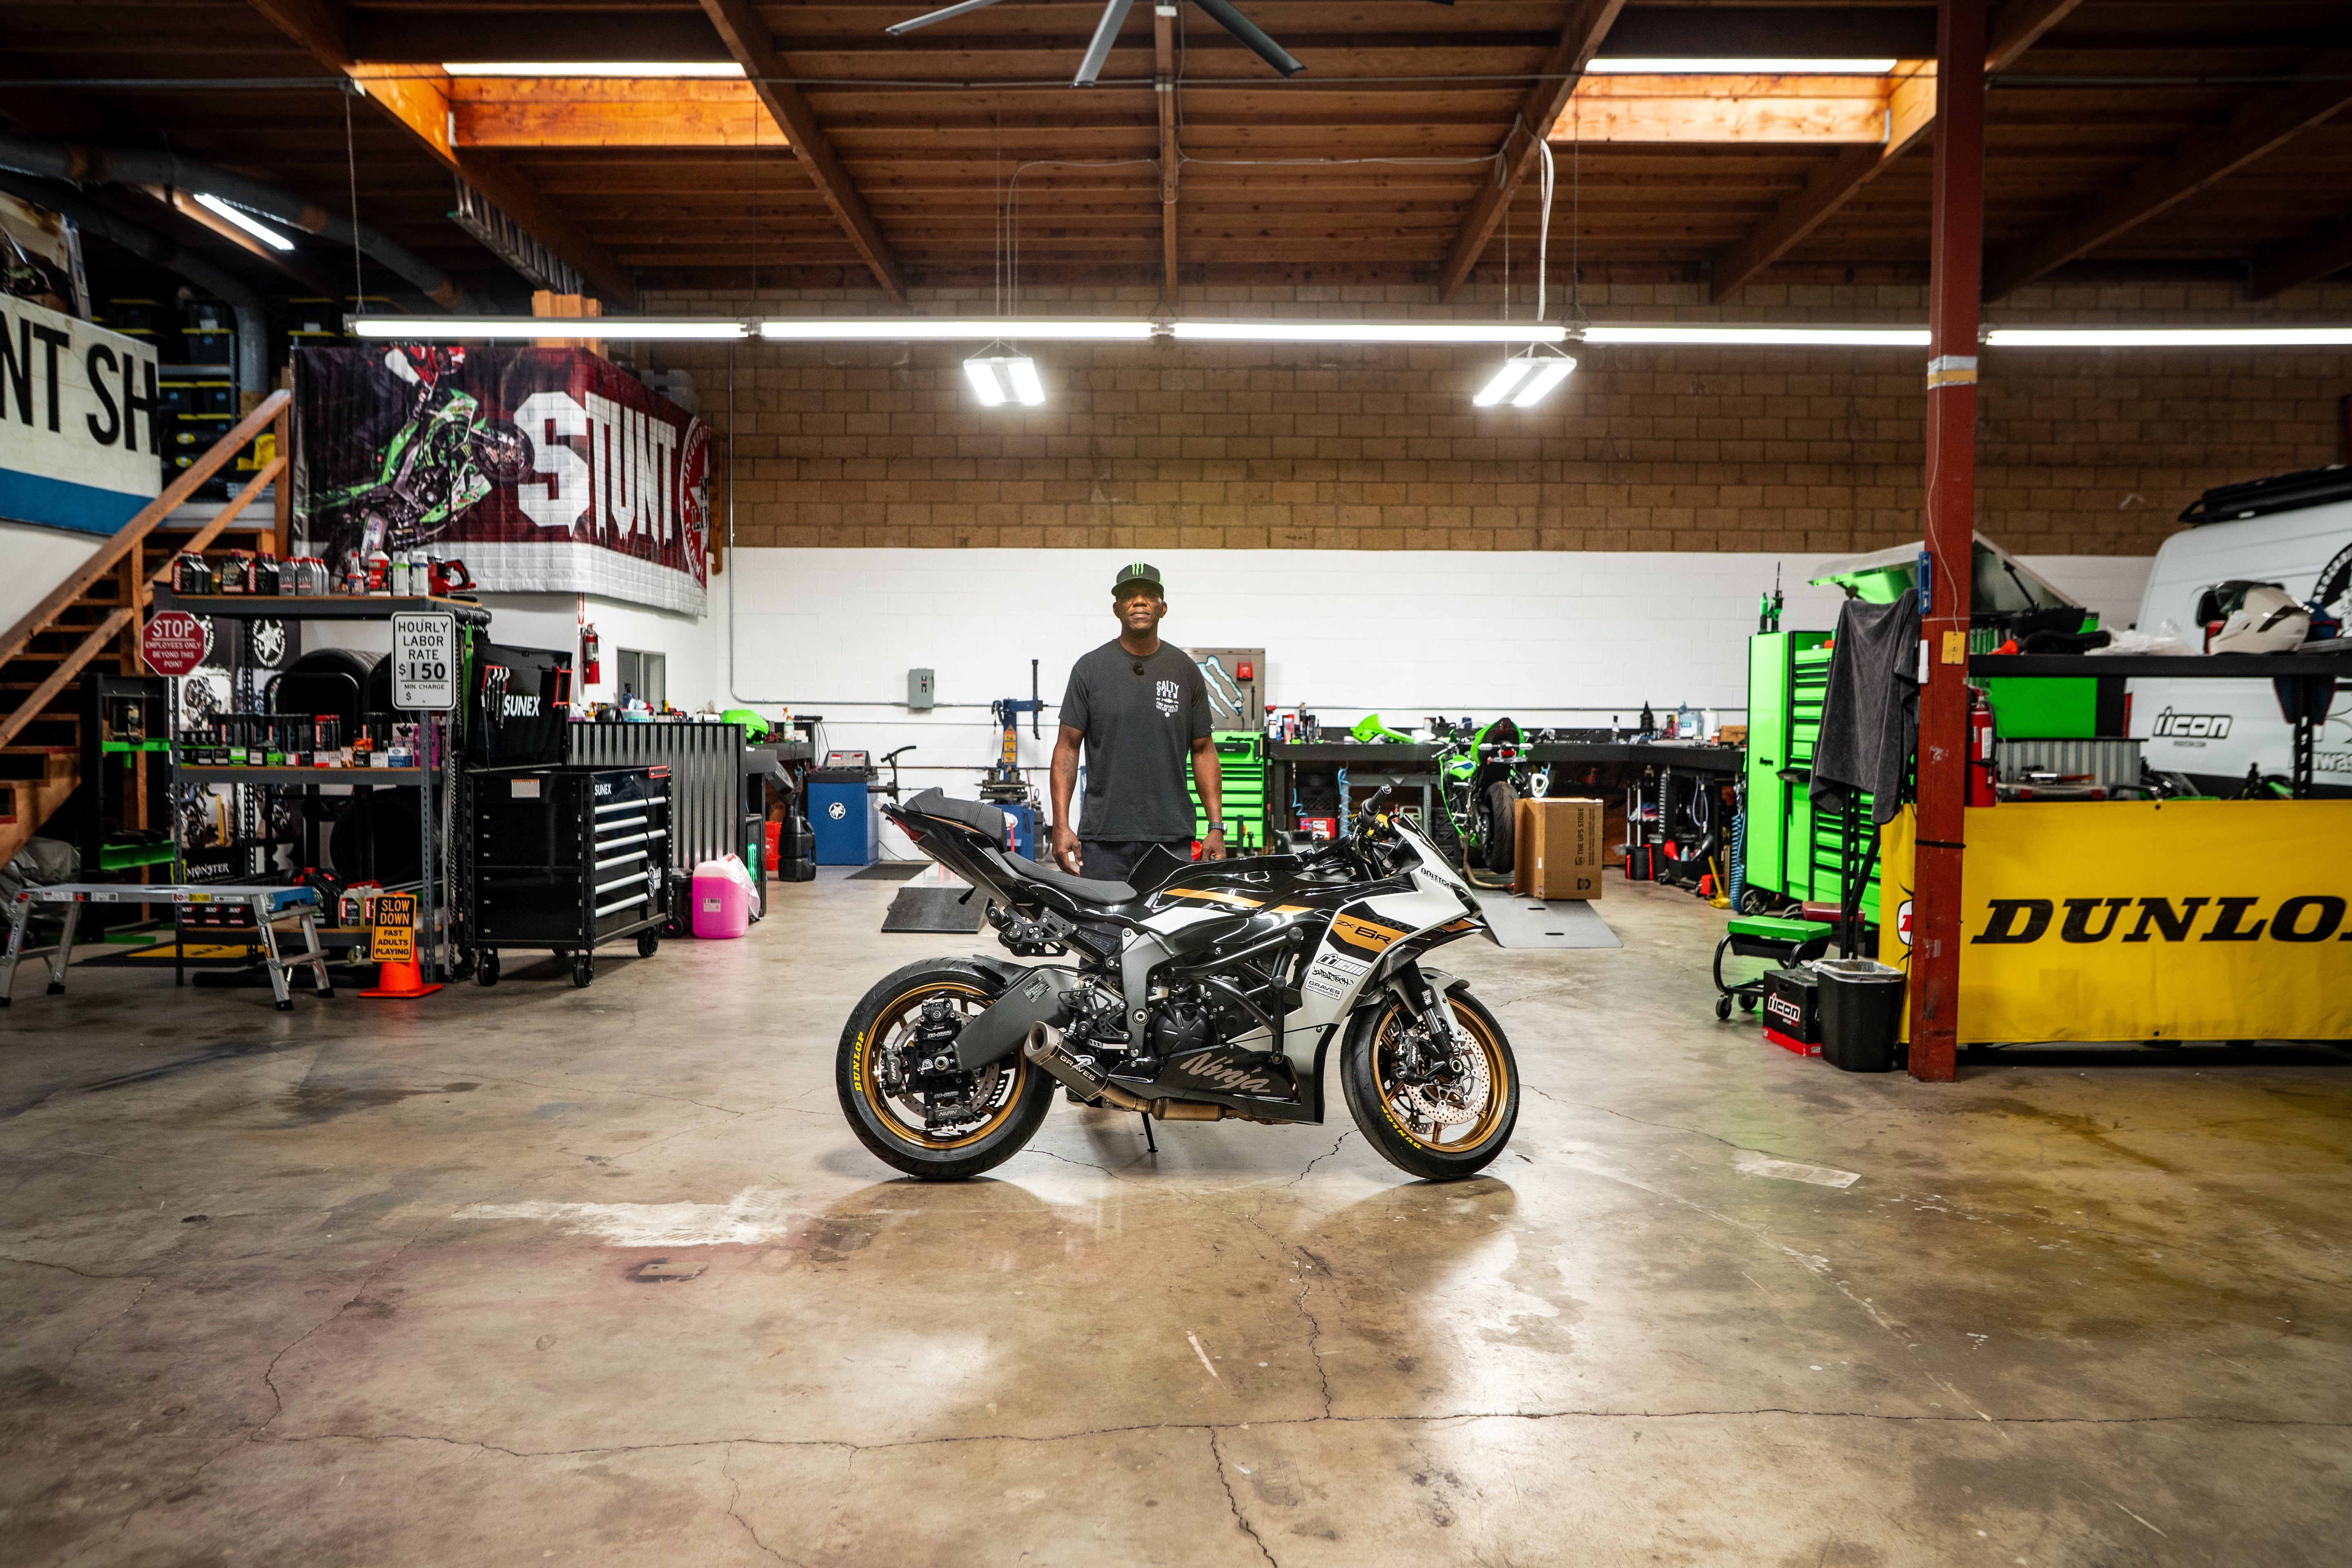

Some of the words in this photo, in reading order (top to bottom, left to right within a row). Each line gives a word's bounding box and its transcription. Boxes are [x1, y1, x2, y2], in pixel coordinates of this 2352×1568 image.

[514, 391, 677, 546] STUNT
[152, 619, 194, 638] STOP
[398, 621, 448, 633] HOURLY
[145, 641, 183, 649] EMPLOYEES
[403, 635, 443, 646] LABOR
[409, 649, 439, 660] RATE
[1156, 680, 1179, 694] SALTY
[1157, 690, 1178, 699] CREW
[503, 694, 540, 717] SUNEX
[595, 783, 612, 796] SUNEX
[187, 862, 229, 878] MONSTER
[1421, 868, 1452, 891] BRITTON
[381, 900, 410, 912] SLOW
[380, 912, 410, 924] DOWN
[1970, 895, 2352, 944] DUNLO
[1335, 920, 1391, 945] ZX-6R
[1307, 985, 1339, 998] MOTORSPORTS
[1309, 980, 1340, 995] GRAVES
[853, 1031, 864, 1092] DUNLOP
[1060, 1055, 1096, 1081] GRAVES
[1180, 1052, 1270, 1093] Ninja
[1381, 1105, 1422, 1149] DUNLOP
